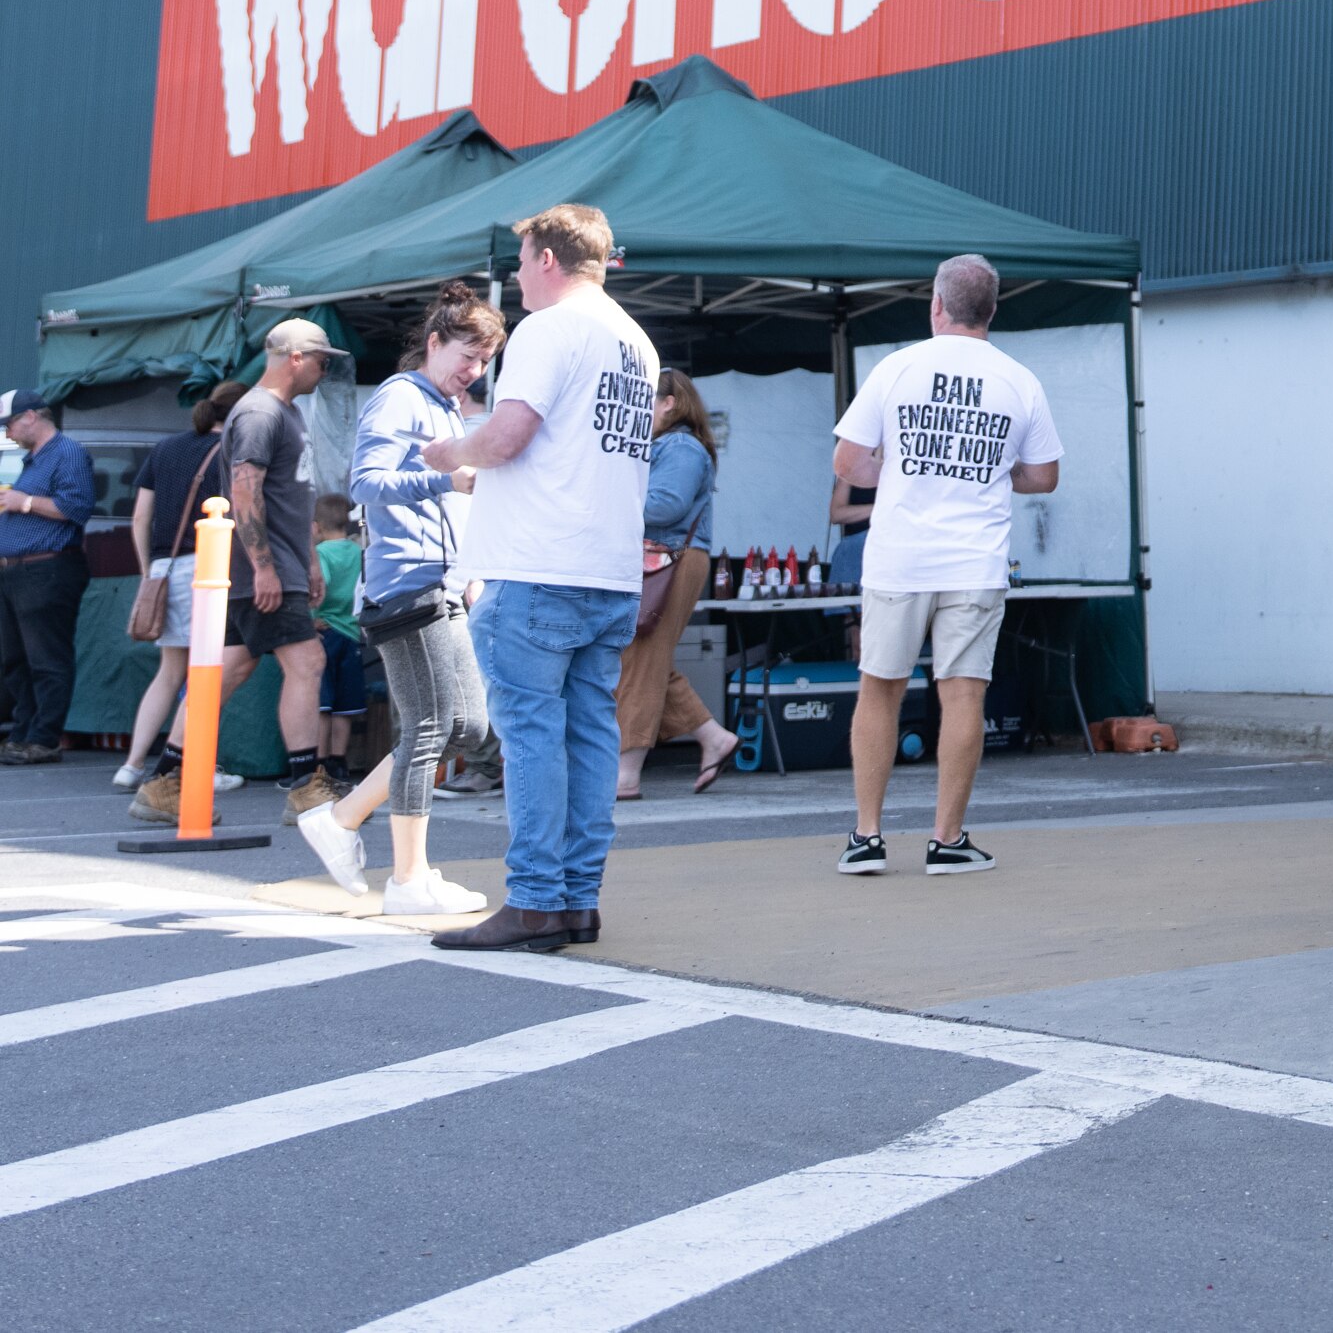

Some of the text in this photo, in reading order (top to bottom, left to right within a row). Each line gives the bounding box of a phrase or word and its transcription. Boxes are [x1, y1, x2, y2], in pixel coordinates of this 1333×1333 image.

[931, 372, 983, 407] BAN
[630, 410, 653, 442] NO
[898, 404, 1012, 440] ENGINEERED
[900, 431, 1005, 467] STONE NOW
[901, 457, 993, 484] CFMEU
[783, 701, 828, 721] Esky
